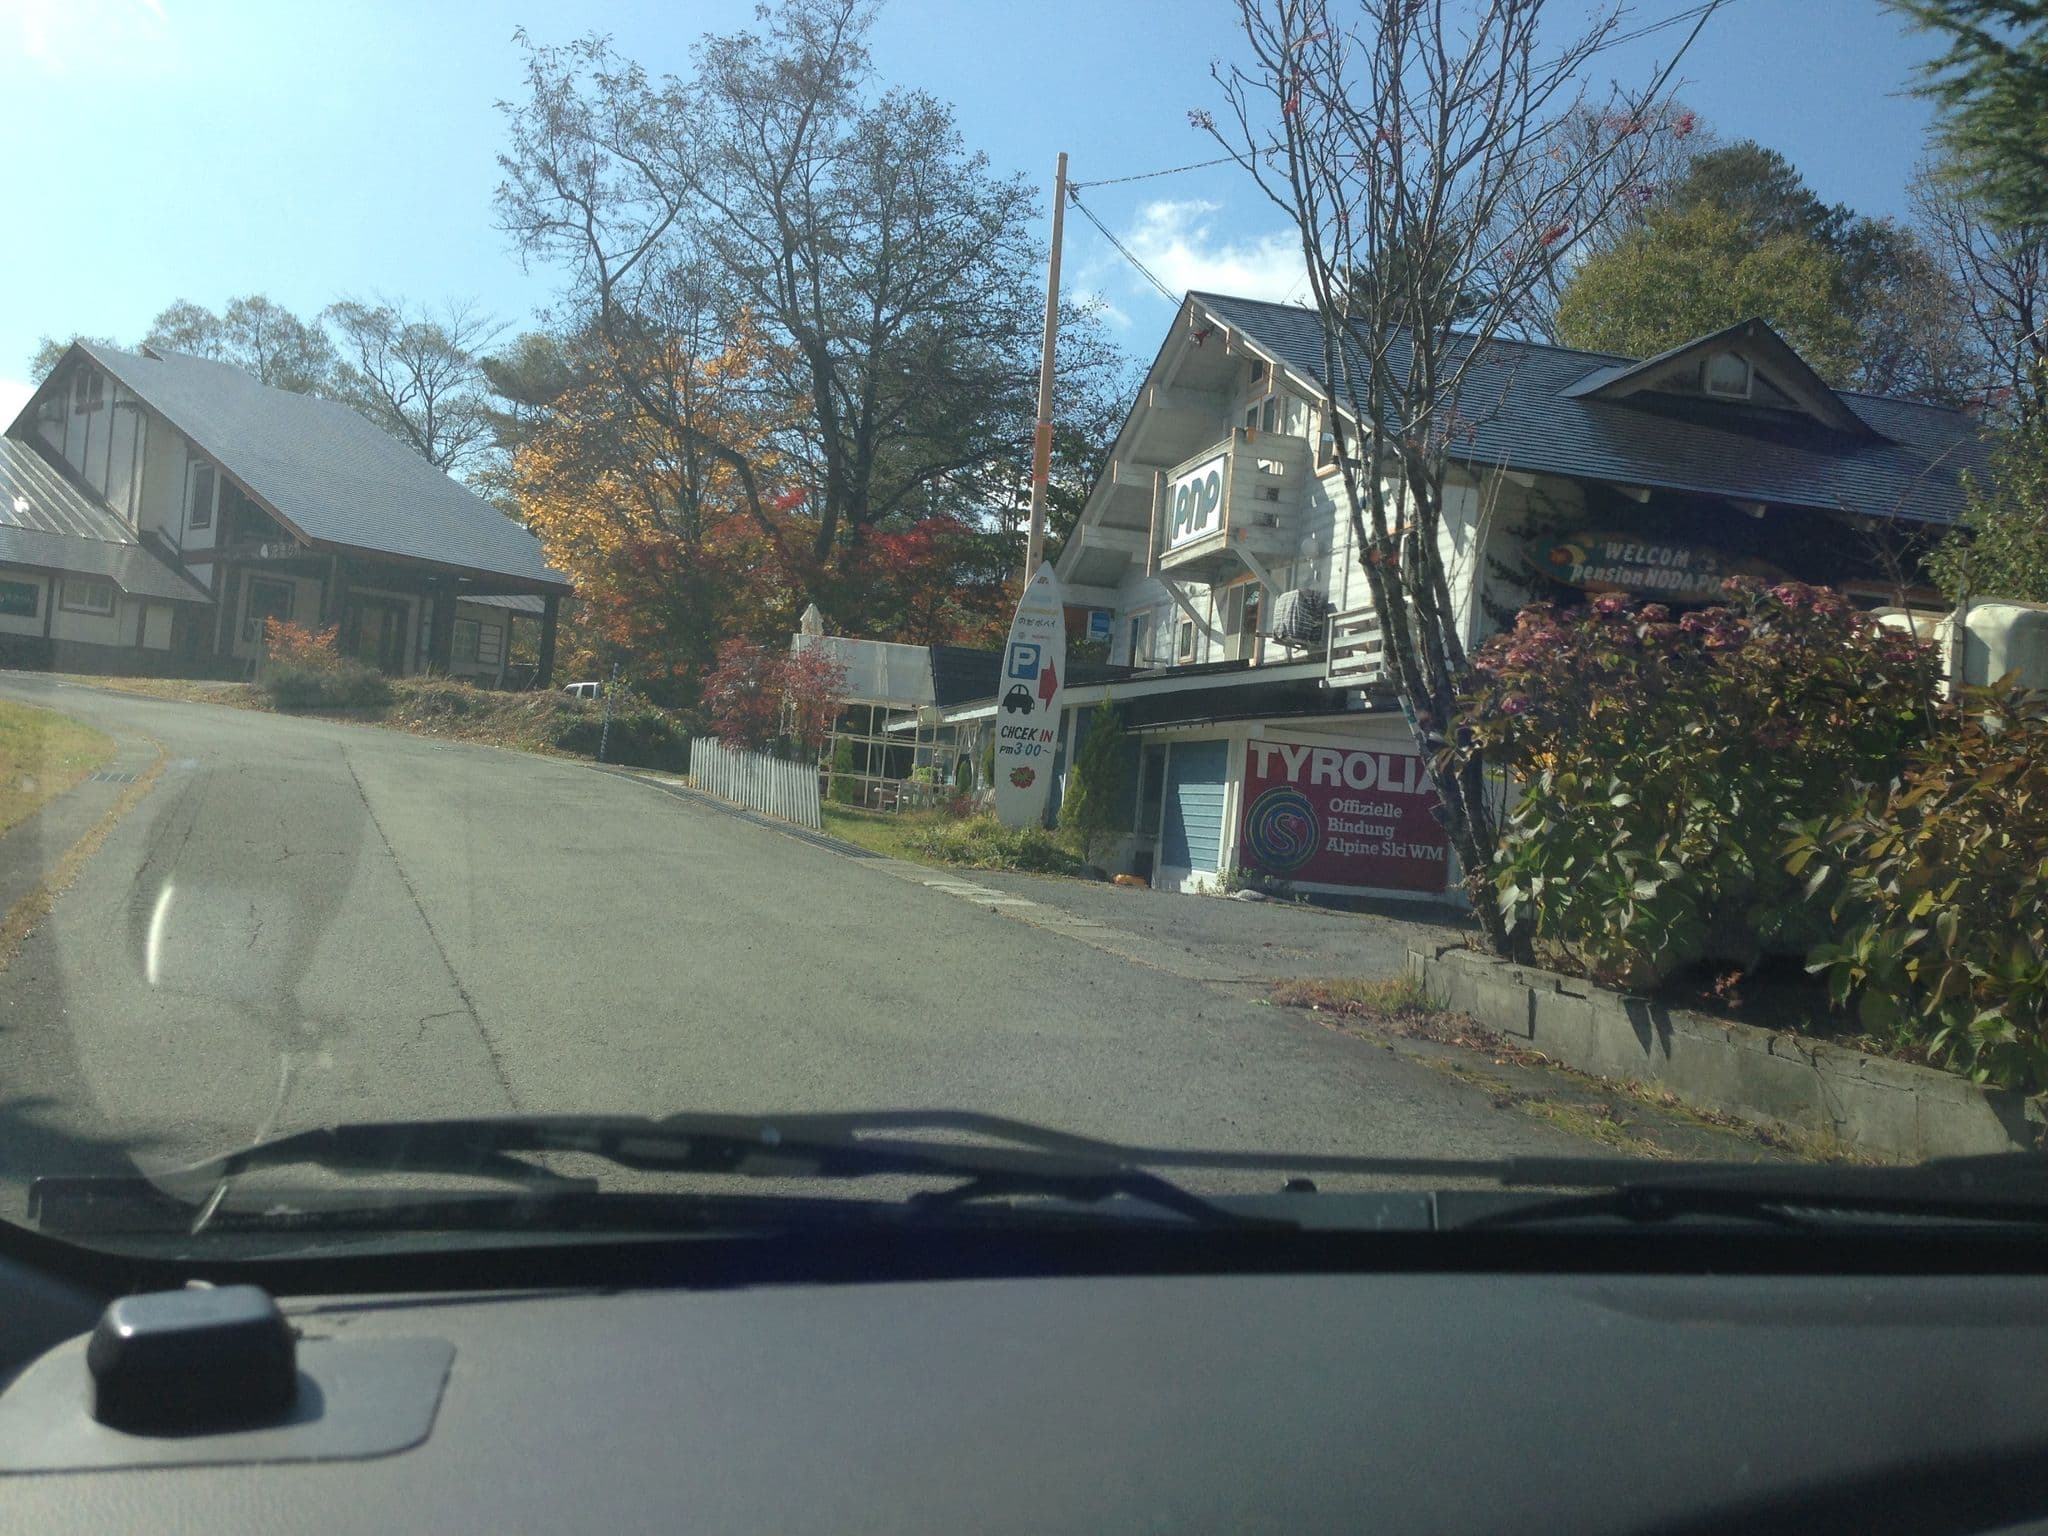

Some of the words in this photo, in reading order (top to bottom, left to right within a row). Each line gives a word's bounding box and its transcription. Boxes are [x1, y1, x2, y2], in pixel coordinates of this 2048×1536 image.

[1011, 646, 1036, 676] P
[1039, 729, 1054, 743] IN
[1329, 798, 1404, 818] Offizielle
[1327, 816, 1396, 840] Bindung
[1326, 836, 1379, 857] Alpine
